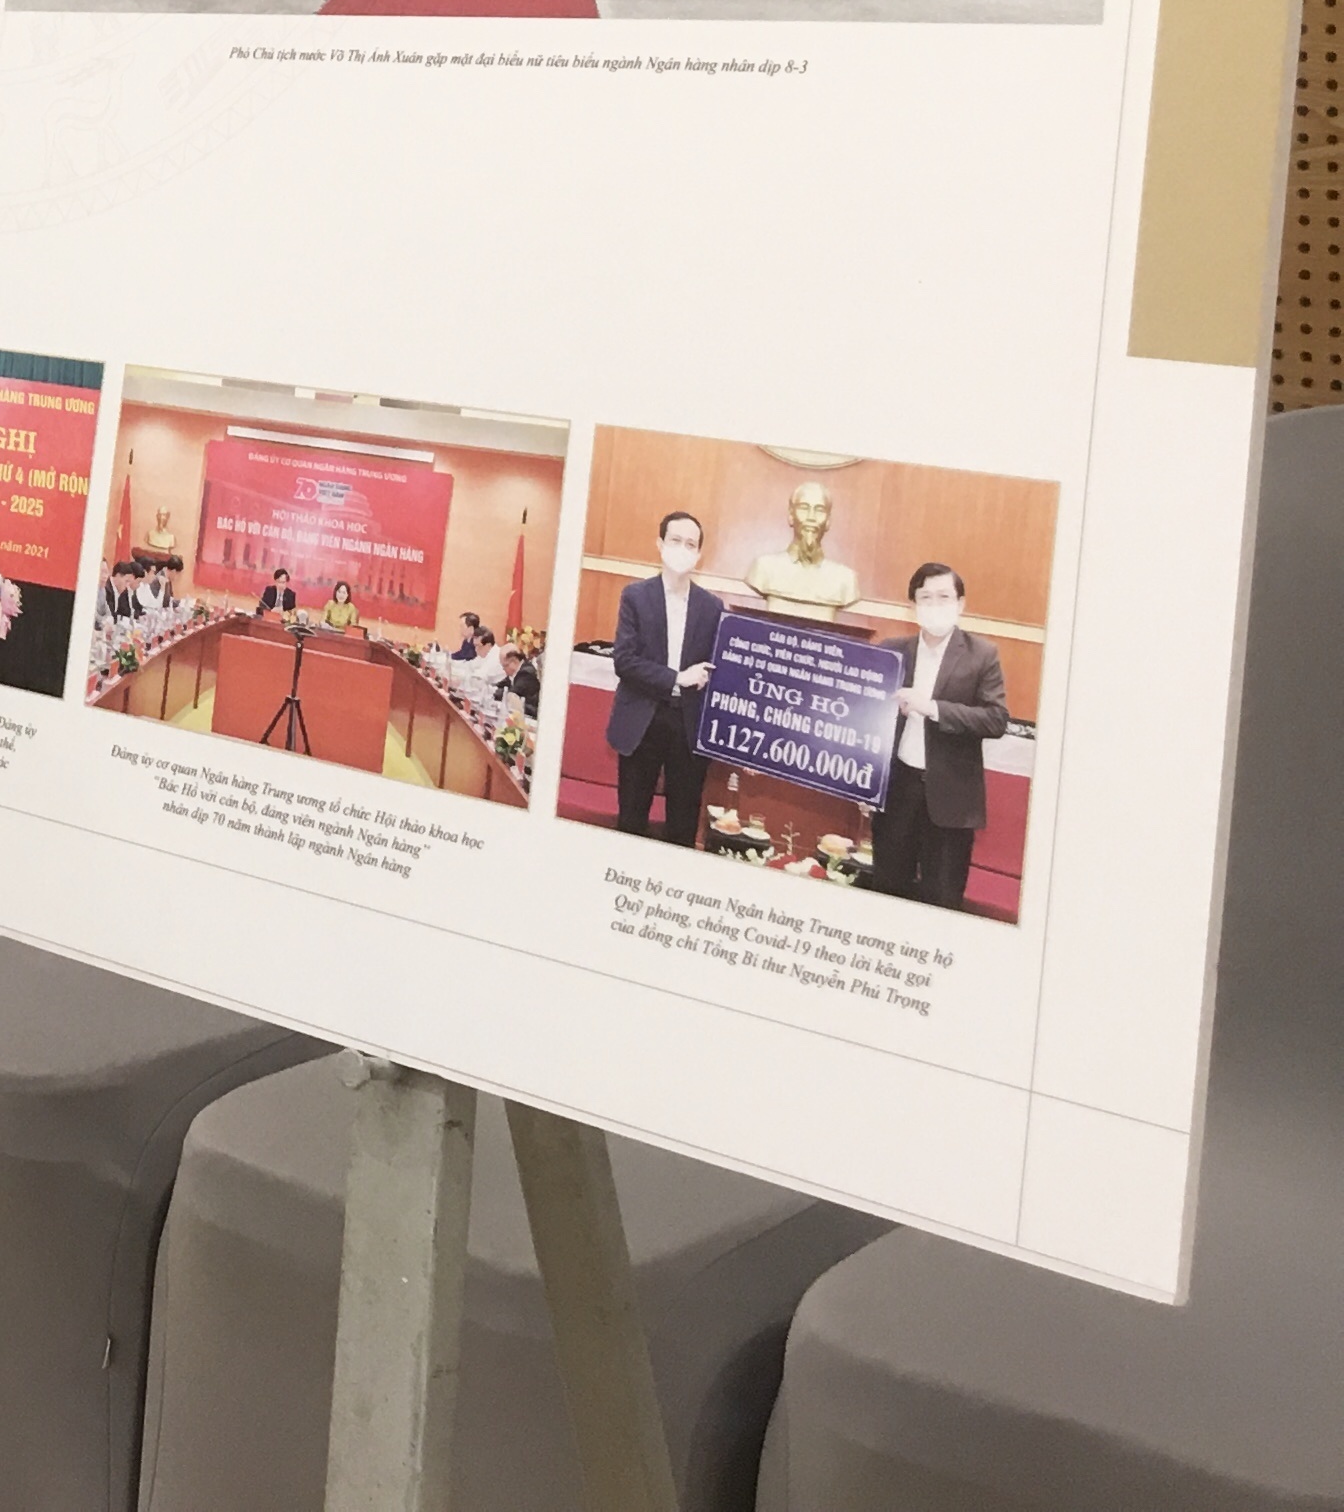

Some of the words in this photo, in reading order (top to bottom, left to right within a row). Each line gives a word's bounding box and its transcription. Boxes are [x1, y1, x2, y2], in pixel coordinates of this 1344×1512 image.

[229, 46, 250, 59] Phó
[252, 47, 275, 60] Chủ
[276, 48, 297, 62] tịch
[298, 49, 327, 62] nước
[330, 49, 345, 62] Võ
[347, 49, 366, 65] Thị
[367, 50, 391, 63] Ánh
[392, 50, 424, 64] Xuân
[424, 52, 448, 68] gặp
[450, 53, 474, 67] mặt
[474, 52, 496, 68] đại
[497, 50, 524, 67] biểu
[526, 54, 544, 67] nữ
[545, 54, 570, 68] tiêu
[571, 51, 600, 69] biểu
[602, 55, 643, 73] ngành
[646, 56, 681, 74] Ngân
[684, 57, 718, 75] hàng
[720, 58, 755, 73] nhân
[757, 59, 782, 77] dịp
[784, 59, 809, 75] 8-3
[10, 494, 44, 517] 2025
[15, 466, 24, 485] 4
[28, 469, 56, 490] (MỞ
[711, 691, 760, 723] PHÒNG,
[763, 705, 811, 734] CHỐNG
[814, 720, 882, 753] COVID-19
[749, 673, 802, 706] ỦNG
[810, 694, 850, 720] HỘ
[708, 720, 873, 789] 1.127.600.000đ
[110, 744, 139, 766] Đảng
[141, 755, 154, 769] ủy
[155, 759, 170, 770] cơ
[170, 763, 198, 777] quan
[202, 766, 229, 786] Ngân
[231, 774, 260, 796] hàng
[262, 781, 295, 805] Trung
[296, 794, 327, 813] ương
[328, 800, 341, 814] tổ
[342, 803, 372, 821] chức
[374, 810, 397, 828] Hội
[398, 817, 426, 835] thảo
[428, 823, 459, 844] khoa
[461, 831, 485, 850] học
[180, 782, 198, 798] Hồ
[200, 789, 217, 805] với
[219, 795, 240, 809] cán
[241, 797, 258, 815] bộ,
[260, 803, 290, 825] đảng
[292, 814, 316, 829] viên
[318, 821, 354, 839] ngành
[357, 827, 389, 848] Ngân
[162, 800, 190, 817] nhân
[190, 806, 210, 825] dịp
[213, 811, 226, 826] 70
[226, 818, 251, 834] năm
[253, 823, 285, 843] thành
[287, 831, 306, 851] lập
[308, 840, 344, 858] ngành
[349, 847, 379, 867] Ngân
[380, 855, 412, 879] hàng
[604, 867, 642, 893] Đảng
[645, 877, 663, 896] bộ
[665, 887, 684, 900] cơ
[686, 892, 722, 910] quan
[725, 897, 764, 920] Ngân
[767, 907, 805, 934] hàng
[809, 917, 853, 946] Trung
[856, 934, 896, 957] ương
[900, 944, 930, 965] ủng
[933, 948, 954, 969] hộ
[614, 894, 643, 914] Quỹ
[645, 904, 692, 929] phòng,
[696, 916, 741, 942] chống
[743, 926, 813, 955] Covid-19
[814, 944, 847, 965] theo
[849, 952, 871, 972] lời
[874, 959, 902, 980] kêu
[905, 972, 932, 988] gọi
[610, 920, 635, 935] của
[638, 924, 674, 949] đồng
[675, 934, 699, 952] chí
[702, 939, 739, 966] Tổng
[741, 950, 759, 968] Bí
[761, 956, 787, 975] thư
[789, 962, 846, 991] Nguyễn
[849, 978, 881, 1000] Phú
[886, 987, 931, 1017] Trọng
